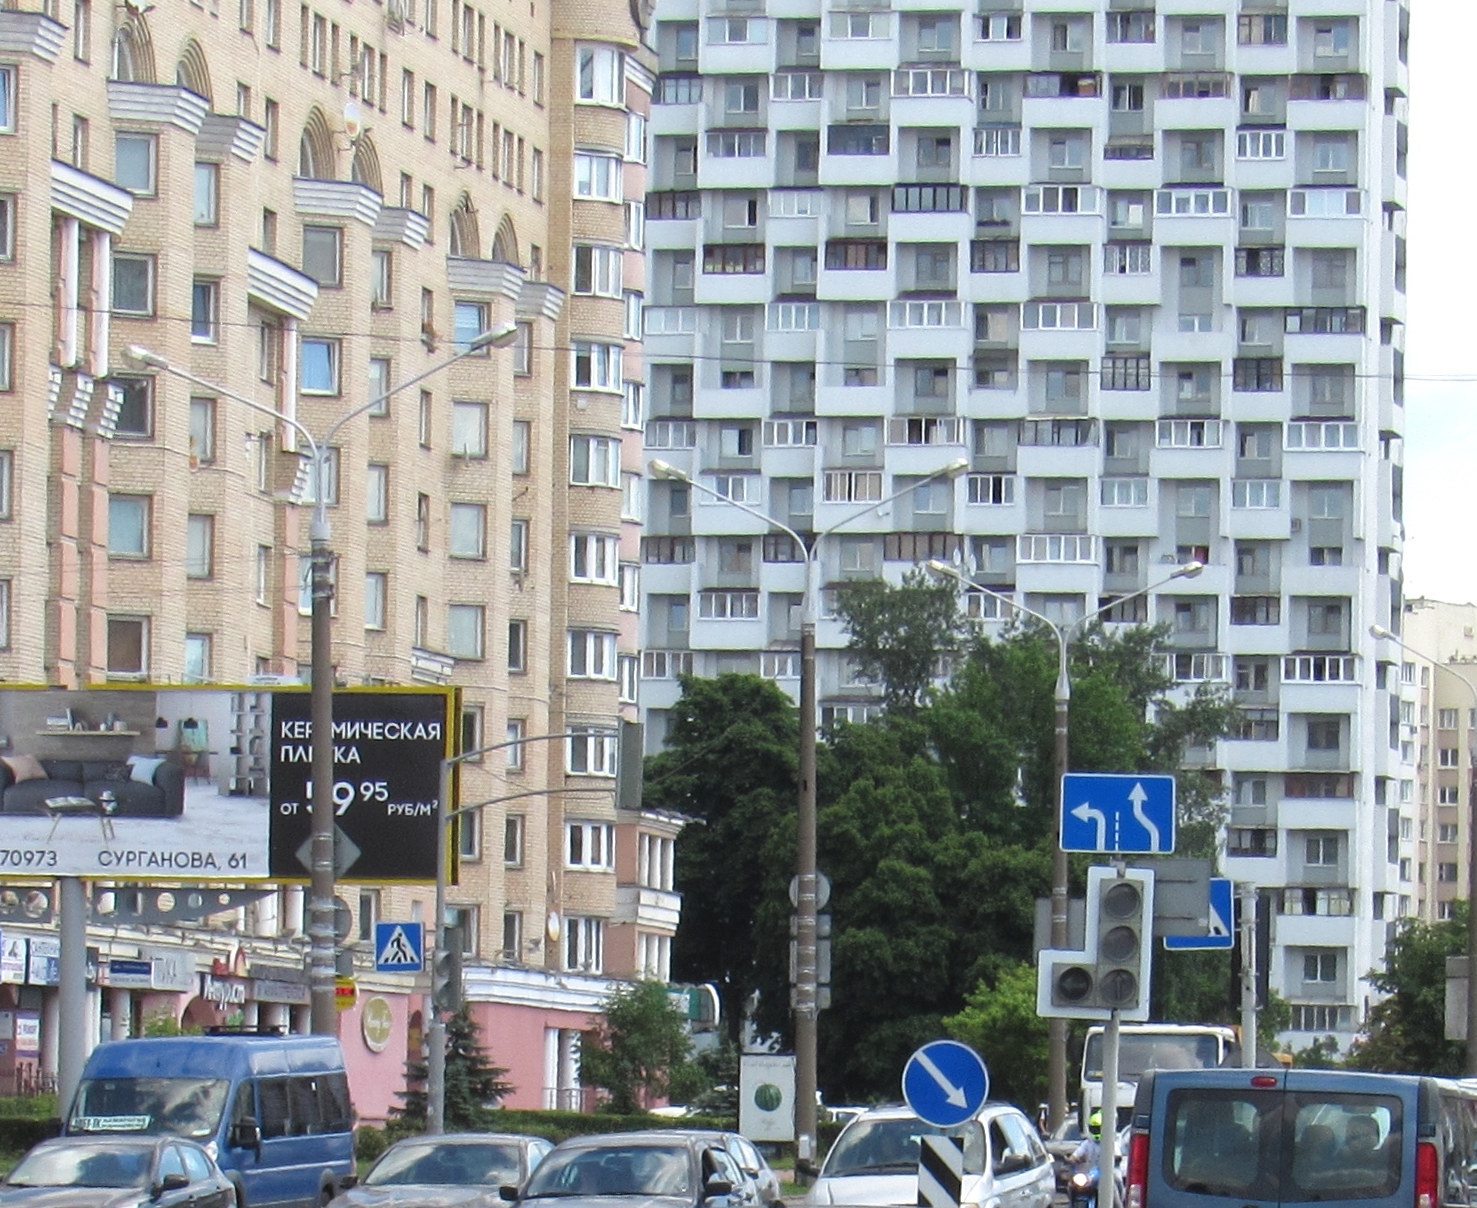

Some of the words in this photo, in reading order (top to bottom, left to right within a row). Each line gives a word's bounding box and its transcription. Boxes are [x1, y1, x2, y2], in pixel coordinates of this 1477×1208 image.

[281, 721, 441, 740] КЕРМИЧЕСКАЯ
[280, 745, 361, 764] ПЛКА
[280, 803, 300, 815] ОТ
[360, 782, 389, 801] 95
[98, 851, 222, 871] СУРГАНОВА,
[227, 853, 248, 869] 61
